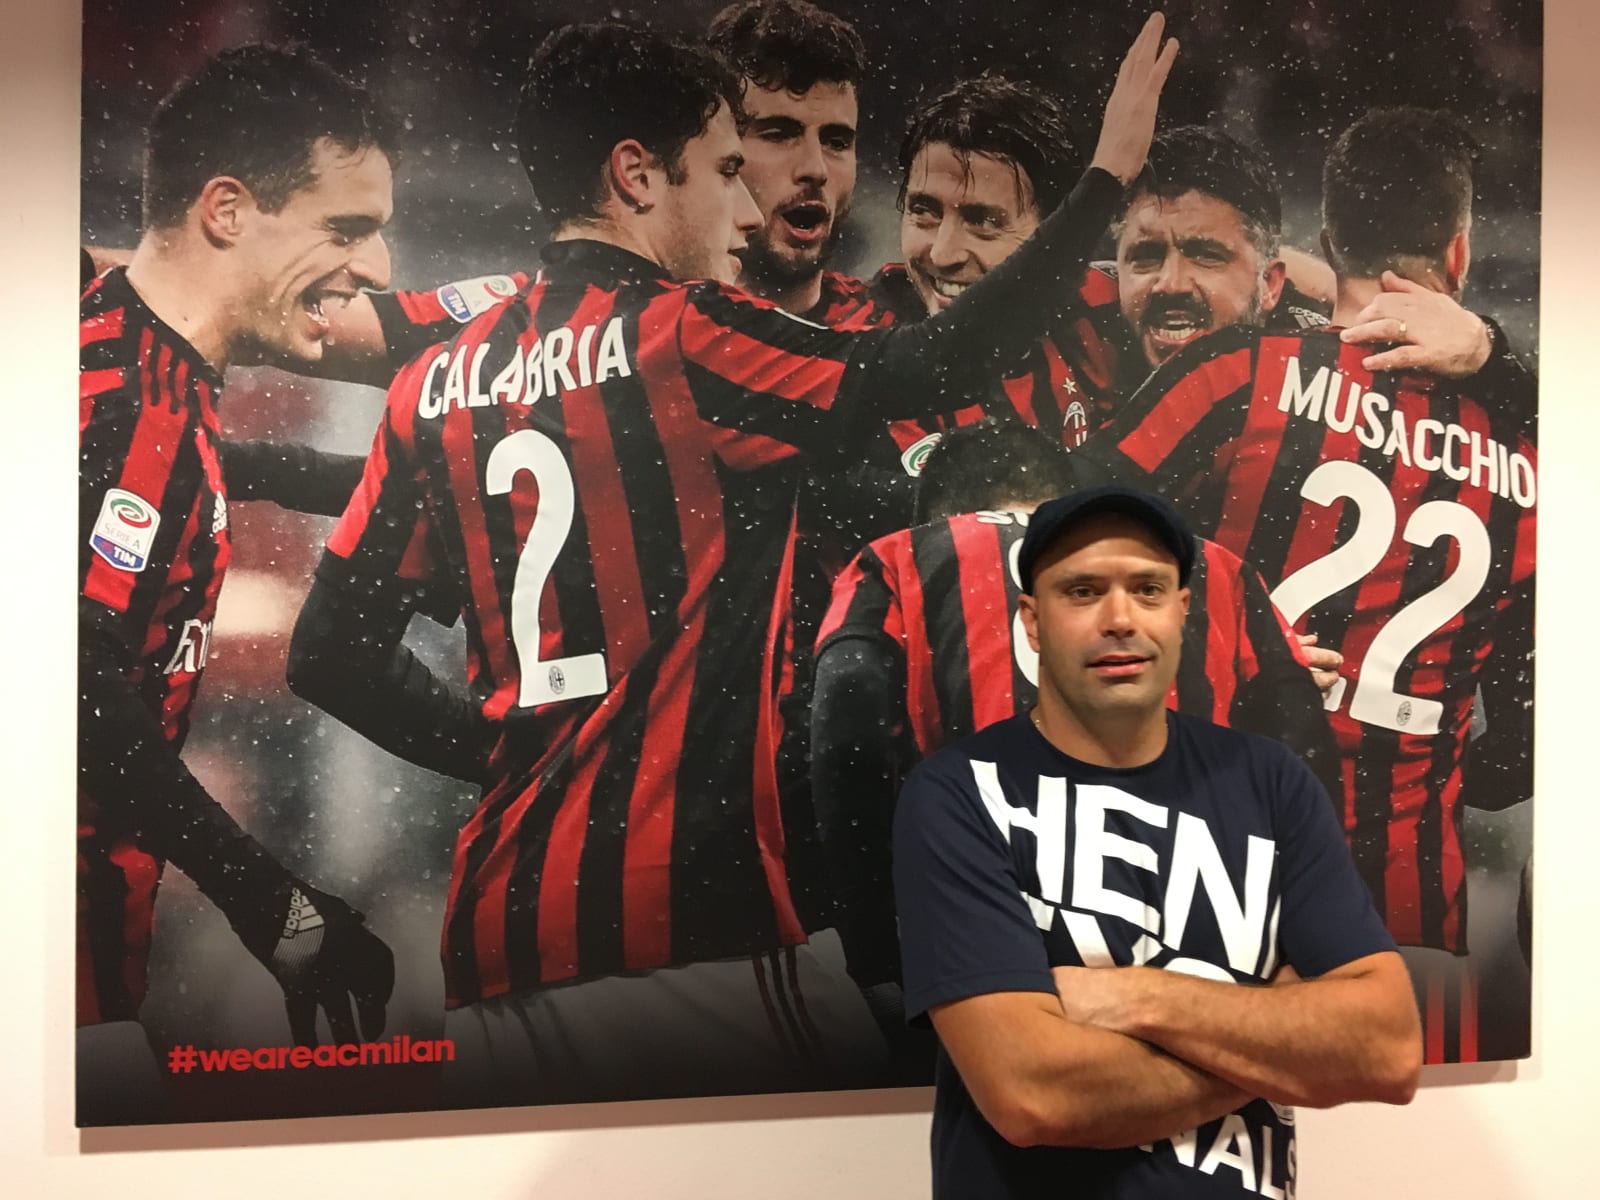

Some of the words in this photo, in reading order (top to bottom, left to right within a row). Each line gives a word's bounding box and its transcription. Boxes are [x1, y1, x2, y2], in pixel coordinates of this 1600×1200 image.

[418, 316, 632, 419] CALABRIA
[1277, 356, 1537, 509] MUSACCHIO
[113, 545, 137, 568] TIM
[485, 429, 608, 709] 2
[1270, 460, 1492, 735] 22
[167, 1034, 456, 1074] #weareacmilan
